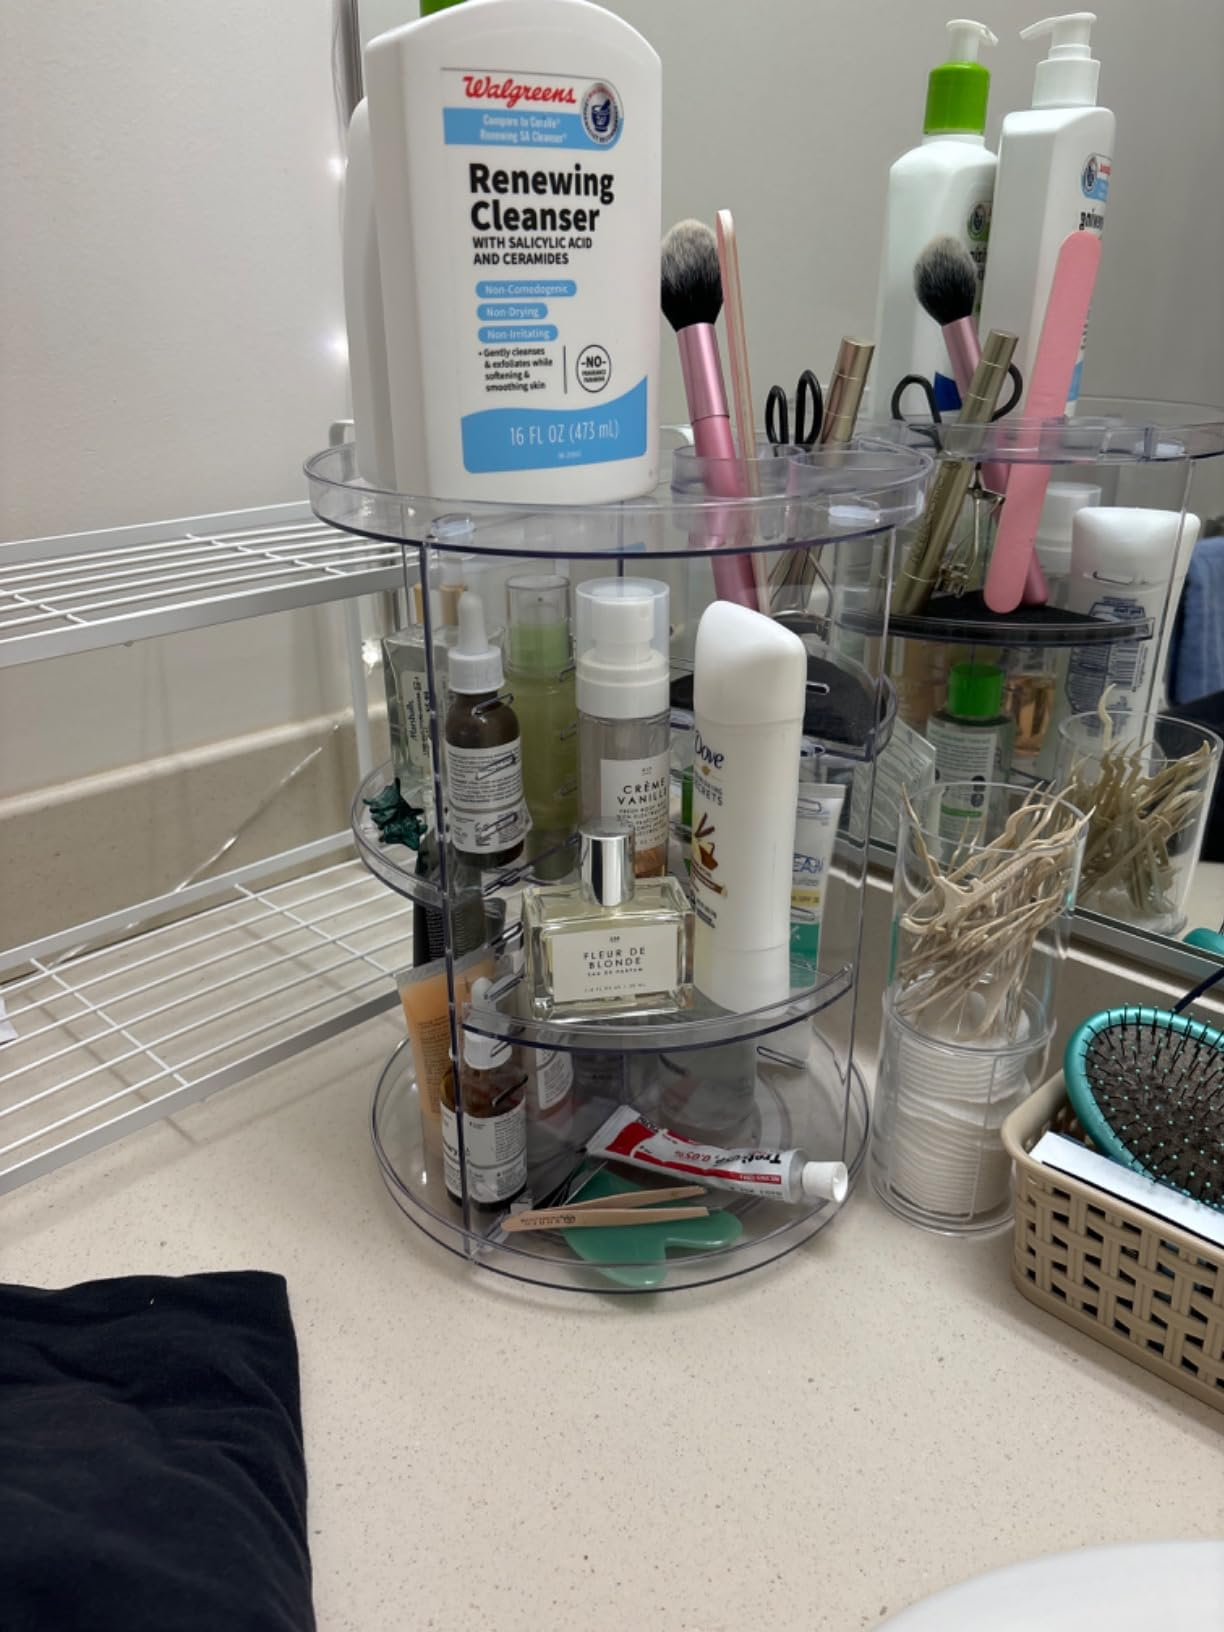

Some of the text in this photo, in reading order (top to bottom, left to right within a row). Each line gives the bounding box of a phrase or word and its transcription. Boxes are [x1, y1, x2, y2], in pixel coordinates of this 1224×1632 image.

[463, 75, 577, 108] Walgreens
[469, 163, 615, 205] Renewing
[470, 199, 600, 232] Cleanser
[472, 236, 592, 249] WITH SALICYLIC ACID
[473, 252, 569, 265] AND CERAMIDES
[484, 283, 568, 297] Non-Comedogenic
[486, 306, 540, 319] Non-Drying
[487, 328, 551, 341] Non-Irritating
[483, 347, 545, 358] Gently cleanses
[532, 357, 553, 367] while
[510, 419, 620, 446] 16 FL OZ (473 mL)
[583, 946, 646, 961] FLEUR DE
[588, 957, 642, 970] BLONDE
